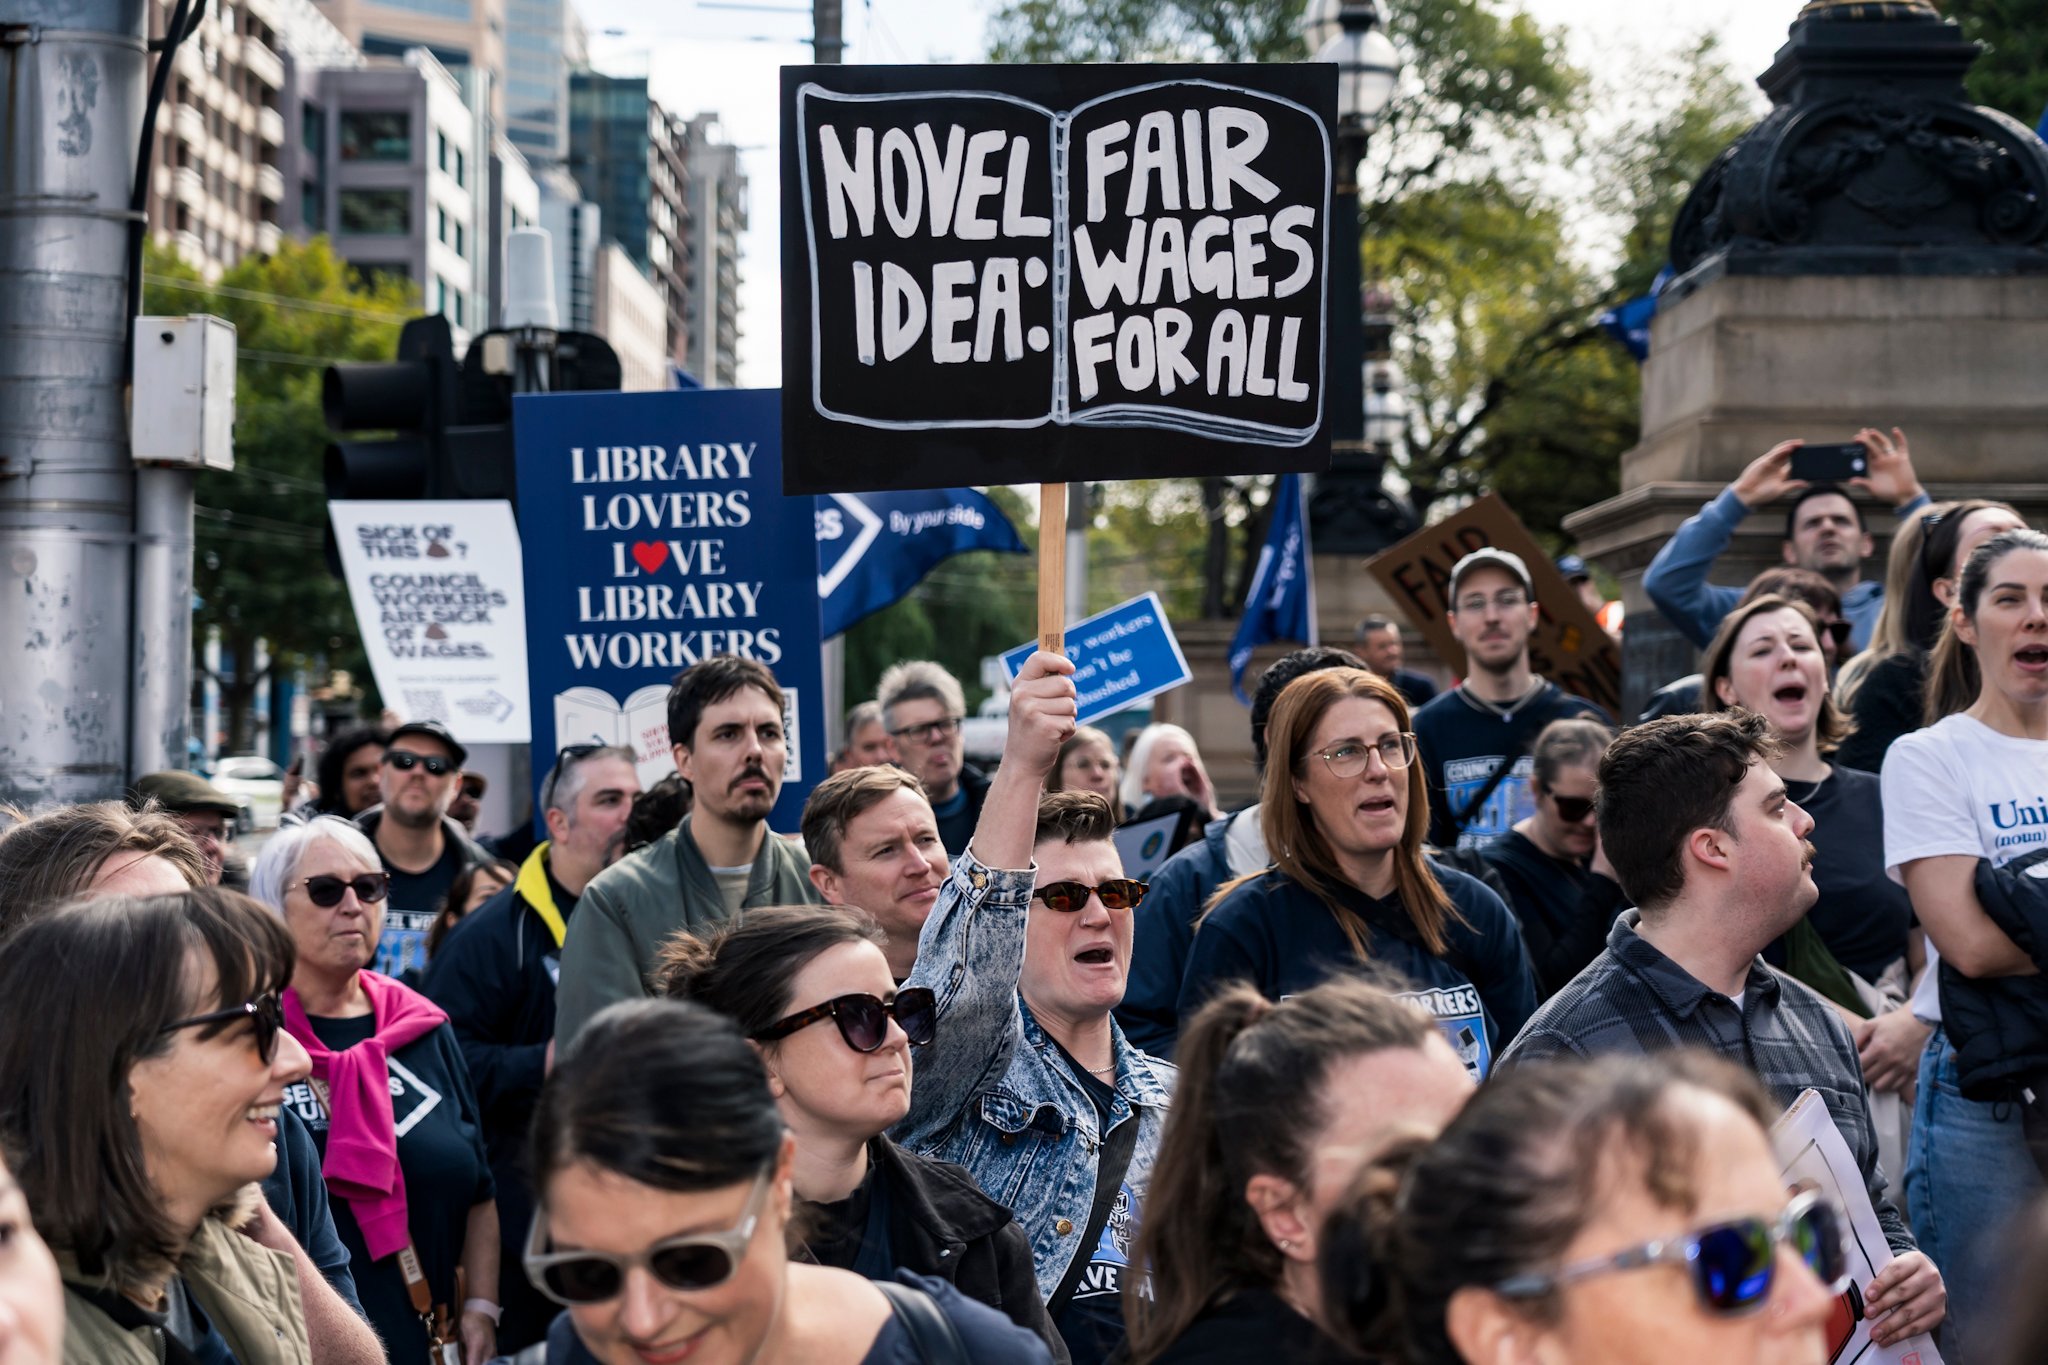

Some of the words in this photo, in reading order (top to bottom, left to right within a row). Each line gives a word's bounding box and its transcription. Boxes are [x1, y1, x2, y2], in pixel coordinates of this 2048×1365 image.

[819, 122, 1051, 240] NOVEL
[1086, 106, 1282, 223] FAIR
[1073, 205, 1315, 310] WAGES
[853, 256, 1050, 365] IDEA:
[1073, 307, 1200, 402] FOR
[1207, 308, 1310, 402] ALL
[571, 442, 757, 483] LIBRARY
[582, 489, 751, 531] LOVERS
[889, 509, 911, 536] By
[912, 507, 945, 535] your
[945, 503, 985, 530] side
[578, 581, 764, 622] LIBRARY
[564, 628, 783, 669] WORKERS
[1995, 829, 2047, 850] (noun)
